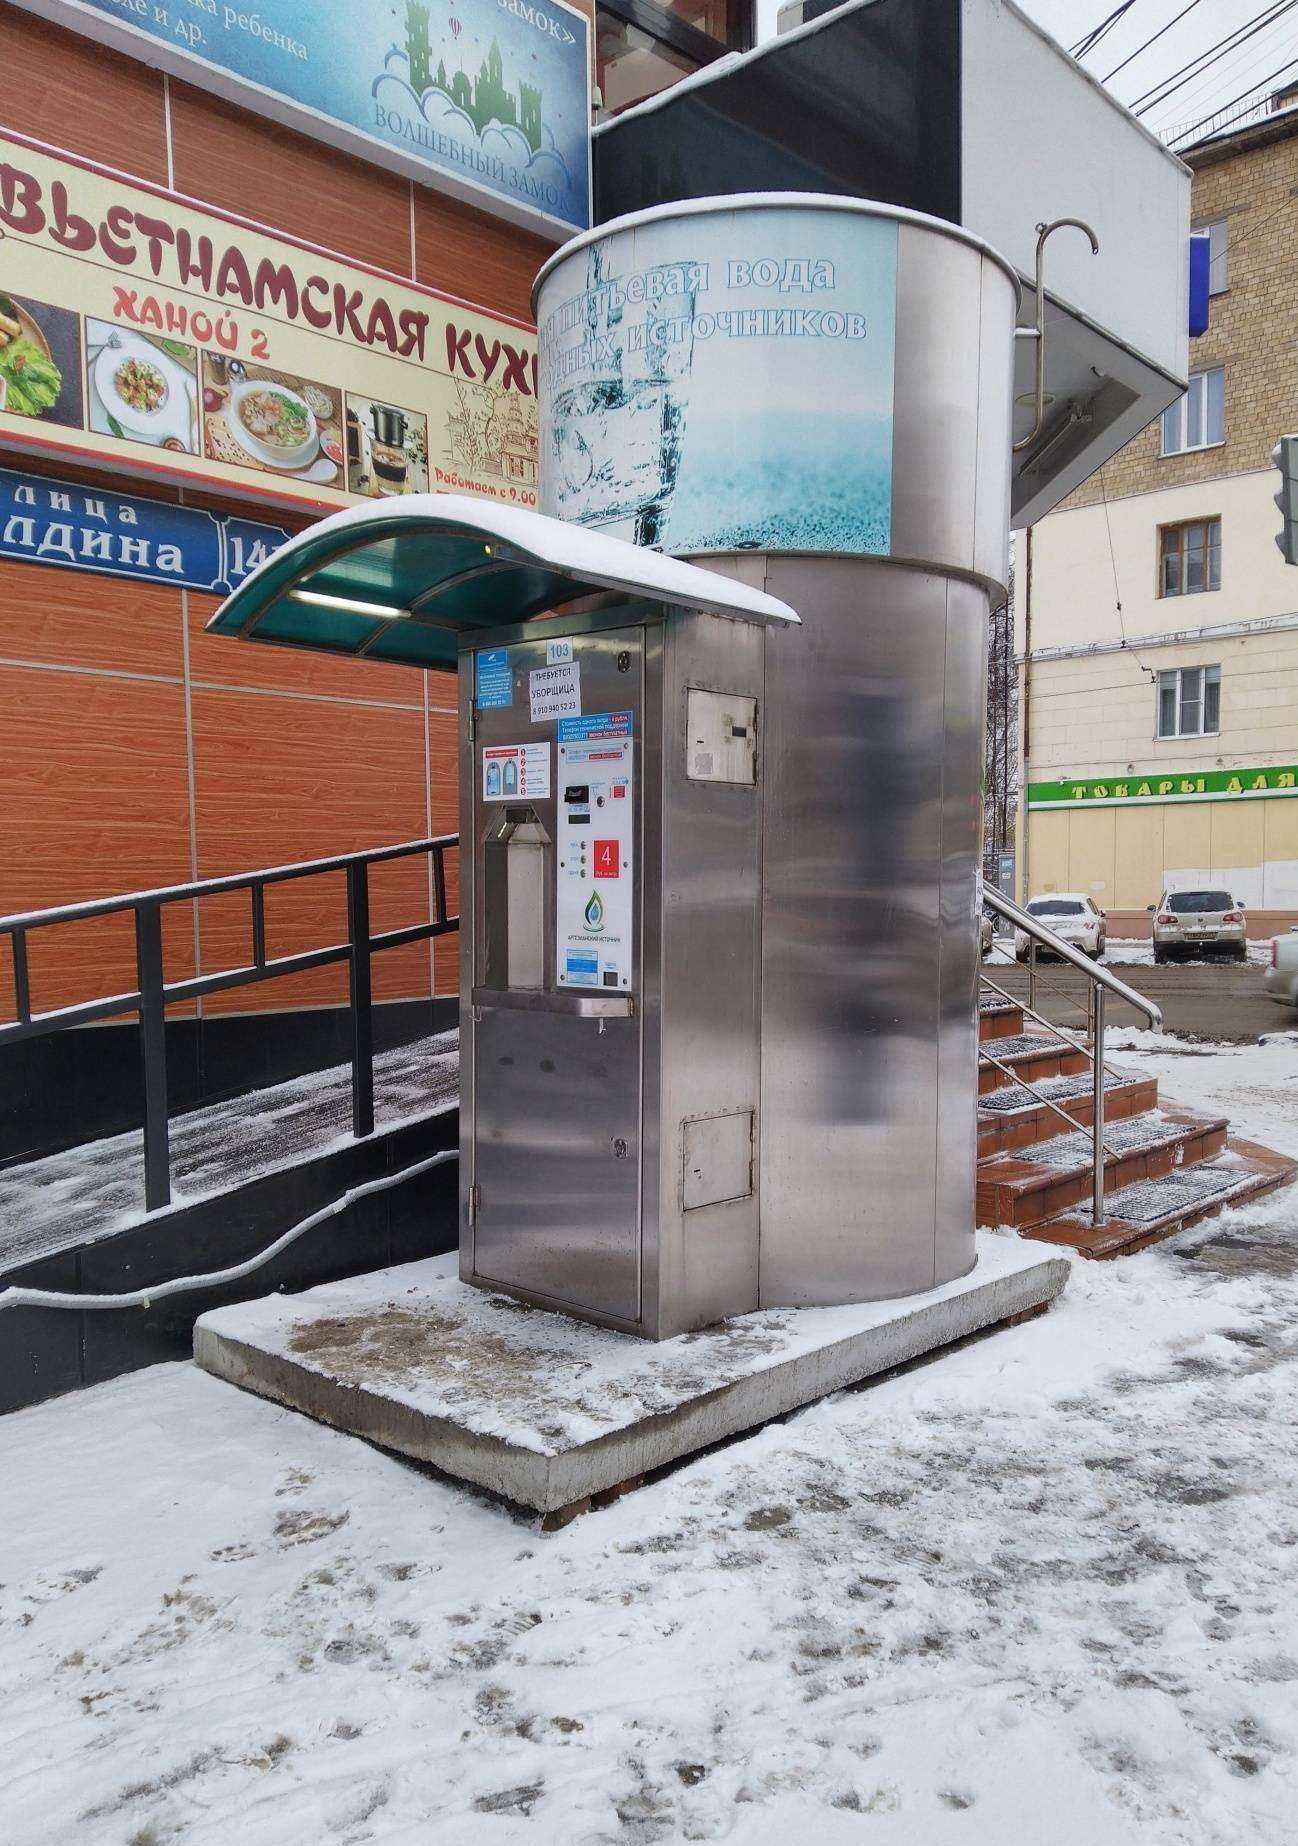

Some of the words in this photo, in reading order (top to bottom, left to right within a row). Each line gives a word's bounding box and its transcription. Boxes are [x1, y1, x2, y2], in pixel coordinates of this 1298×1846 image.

[154, 6, 169, 27] и
[175, 18, 207, 48] др.
[223, 6, 308, 61] ребенка
[374, 103, 506, 182] ВОЛШЕБНЫЙ
[0, 163, 430, 363] ВЬЕТНАМСКАЯ
[727, 257, 836, 293] вода
[112, 285, 239, 351] ХАНОЙ
[250, 328, 271, 360] 2
[627, 309, 868, 353] источников
[434, 467, 497, 496] Работаем
[500, 488, 506, 498] с
[509, 486, 537, 506] 9.00
[230, 537, 282, 576] 14
[550, 643, 569, 658] 103
[531, 683, 575, 699] УБОРЩИЦА
[535, 668, 571, 681] ТРЕБУЕТСЯ
[537, 705, 548, 715] 910
[560, 702, 568, 711] 52
[568, 701, 576, 709] 23
[1071, 778, 1206, 799] ТОВАРЫ
[1226, 773, 1297, 795] ДЛЯ
[601, 846, 612, 866] 4
